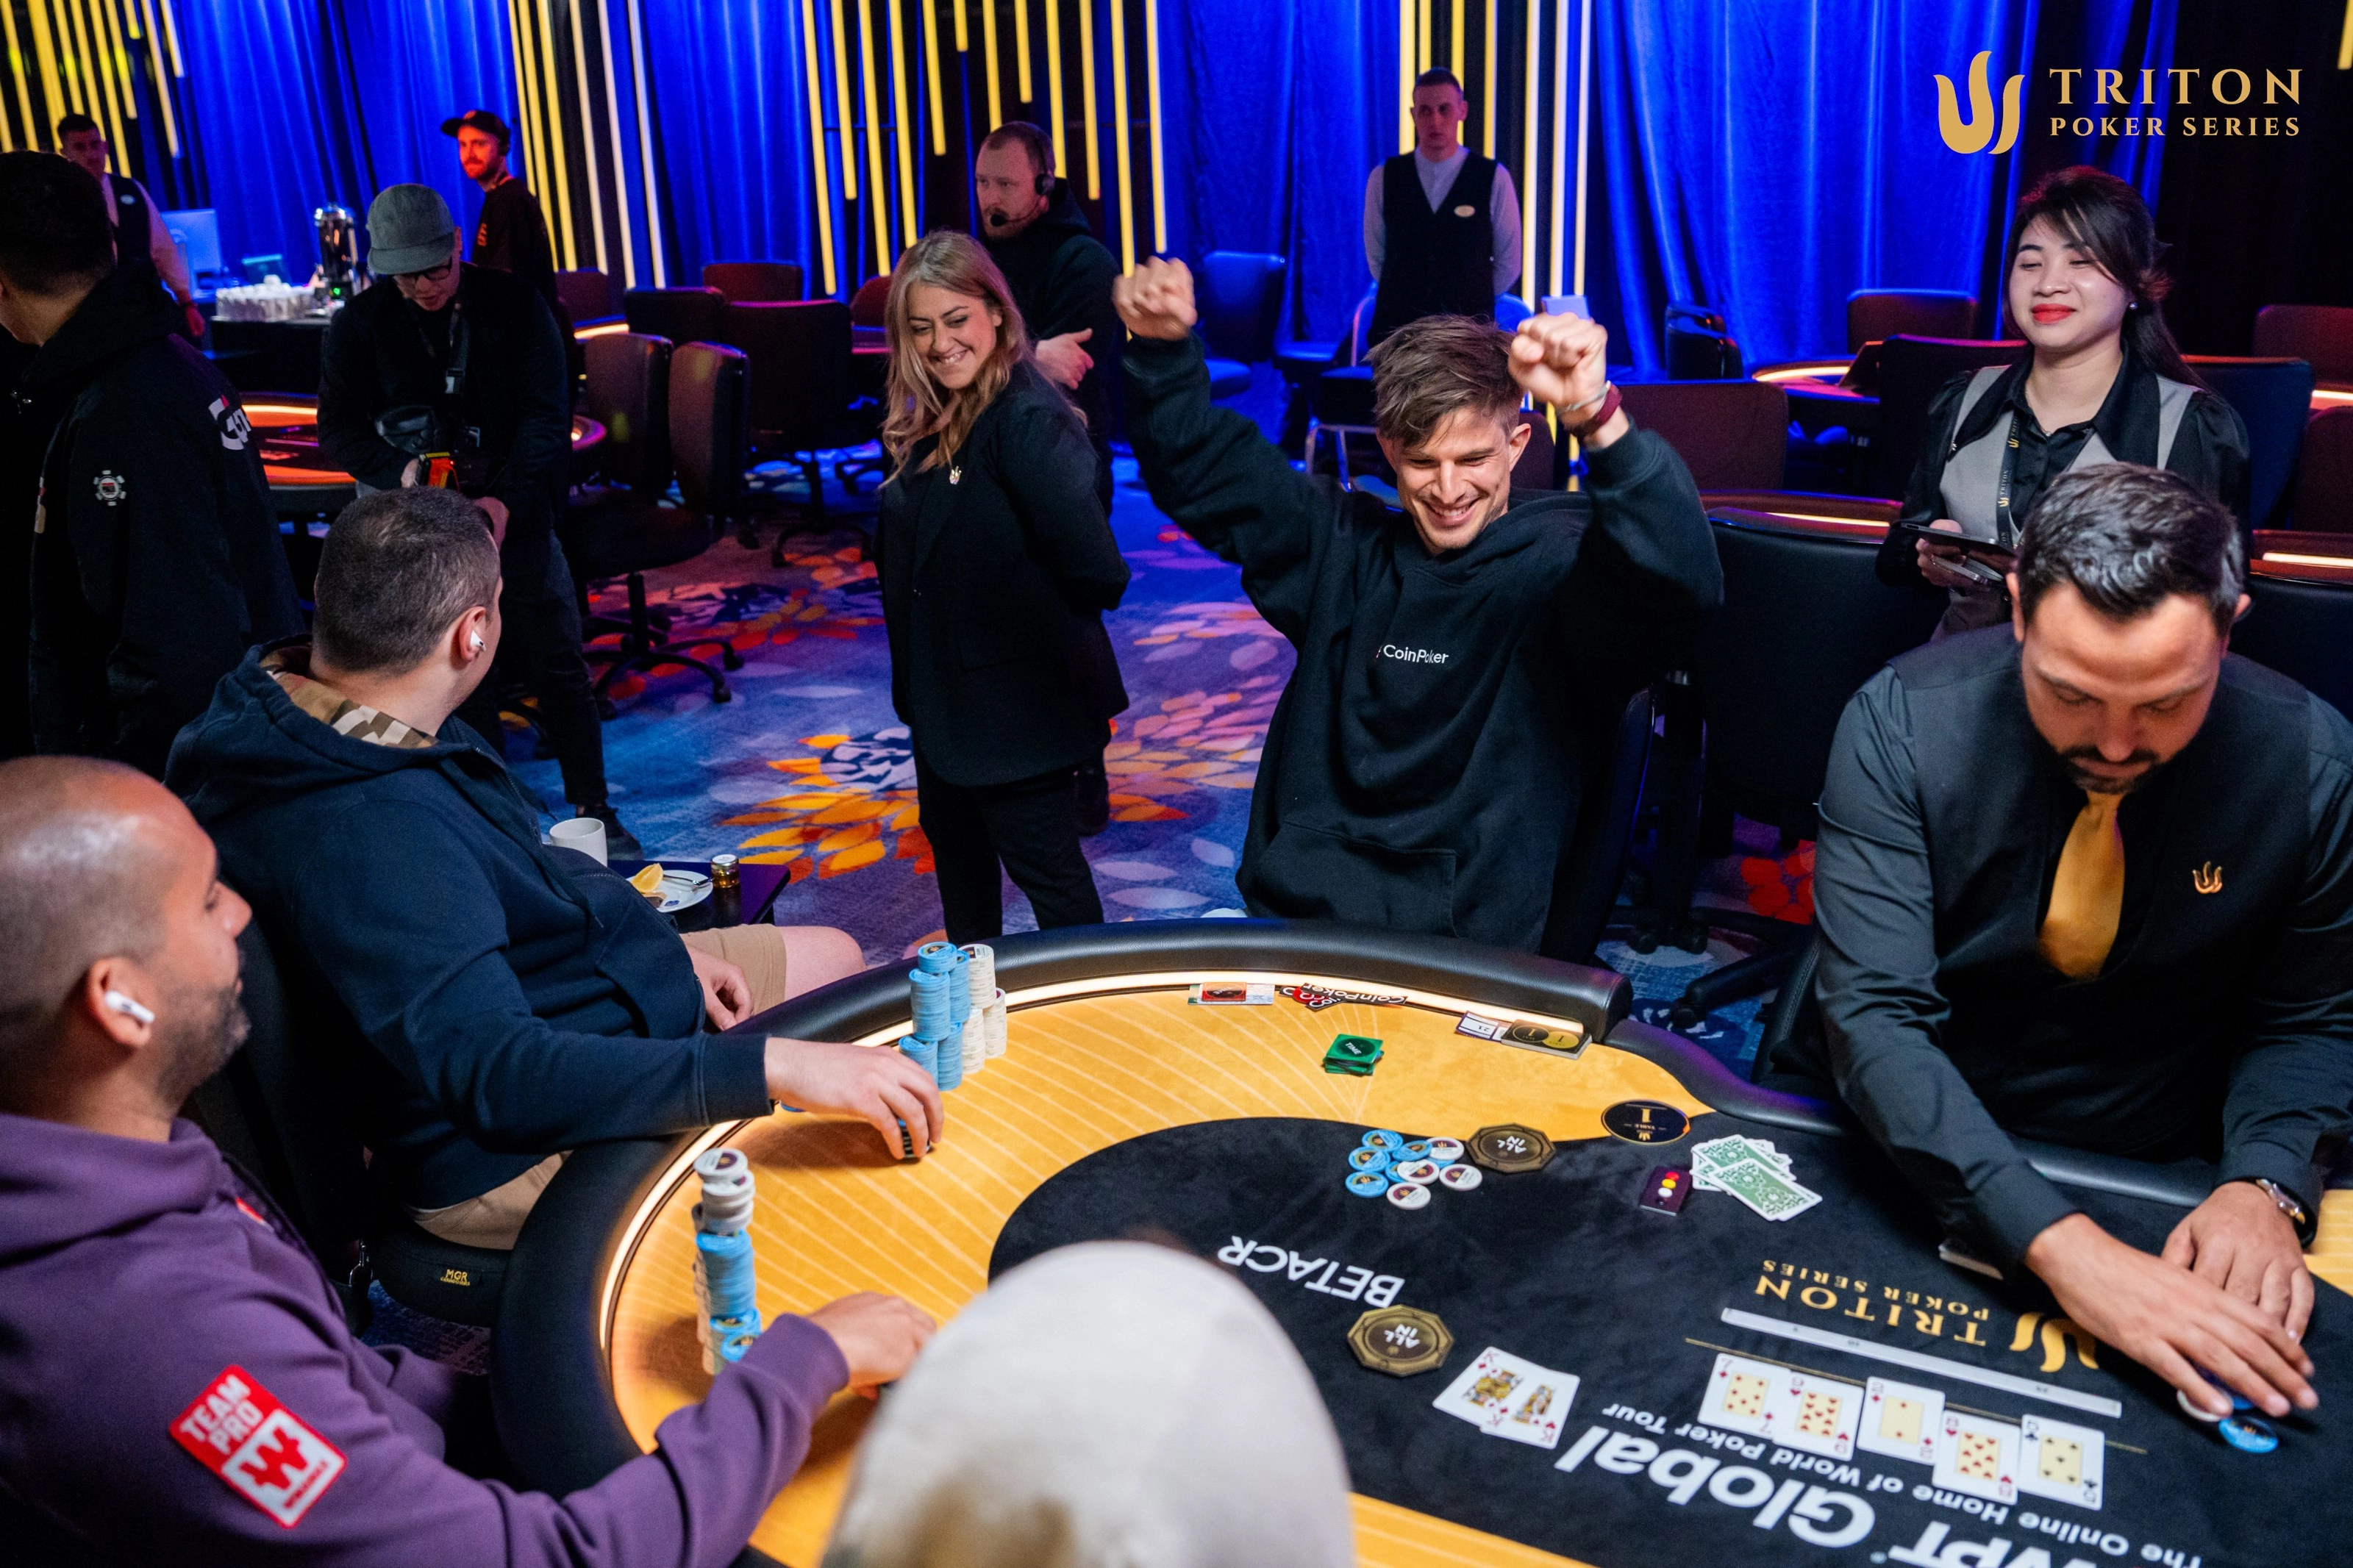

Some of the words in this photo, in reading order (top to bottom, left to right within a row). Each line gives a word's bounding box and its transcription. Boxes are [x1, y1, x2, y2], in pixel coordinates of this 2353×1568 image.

[1382, 644, 1449, 664] CoinPoker
[1302, 984, 1405, 1004] CoinPoker
[1528, 1028, 1537, 1037] 1
[1345, 1042, 1362, 1056] TIME
[1640, 1108, 1652, 1123] 1
[1497, 1139, 1527, 1154] ALL
[1506, 1135, 1526, 1147] IN
[1217, 1235, 1406, 1309] BETACR
[1763, 1259, 1868, 1293] SERIES
[1754, 1274, 1987, 1347] TRITON
[1884, 1284, 1989, 1321] POKER
[1384, 1329, 1421, 1349] ALL
[1395, 1323, 1418, 1339] IN
[1483, 1351, 1499, 1363] K
[1721, 1358, 1733, 1370] 7
[179, 1373, 251, 1443] TEAM
[207, 1398, 264, 1456] PRO
[1486, 1414, 1504, 1428] K
[1602, 1403, 1668, 1434] Tour
[1674, 1422, 1767, 1461] Poker
[1769, 1442, 1862, 1487] World
[1554, 1426, 1876, 1548] Global
[1866, 1473, 1904, 1493] of
[1913, 1485, 2010, 1525] Home
[2018, 1511, 2129, 1556] Online
